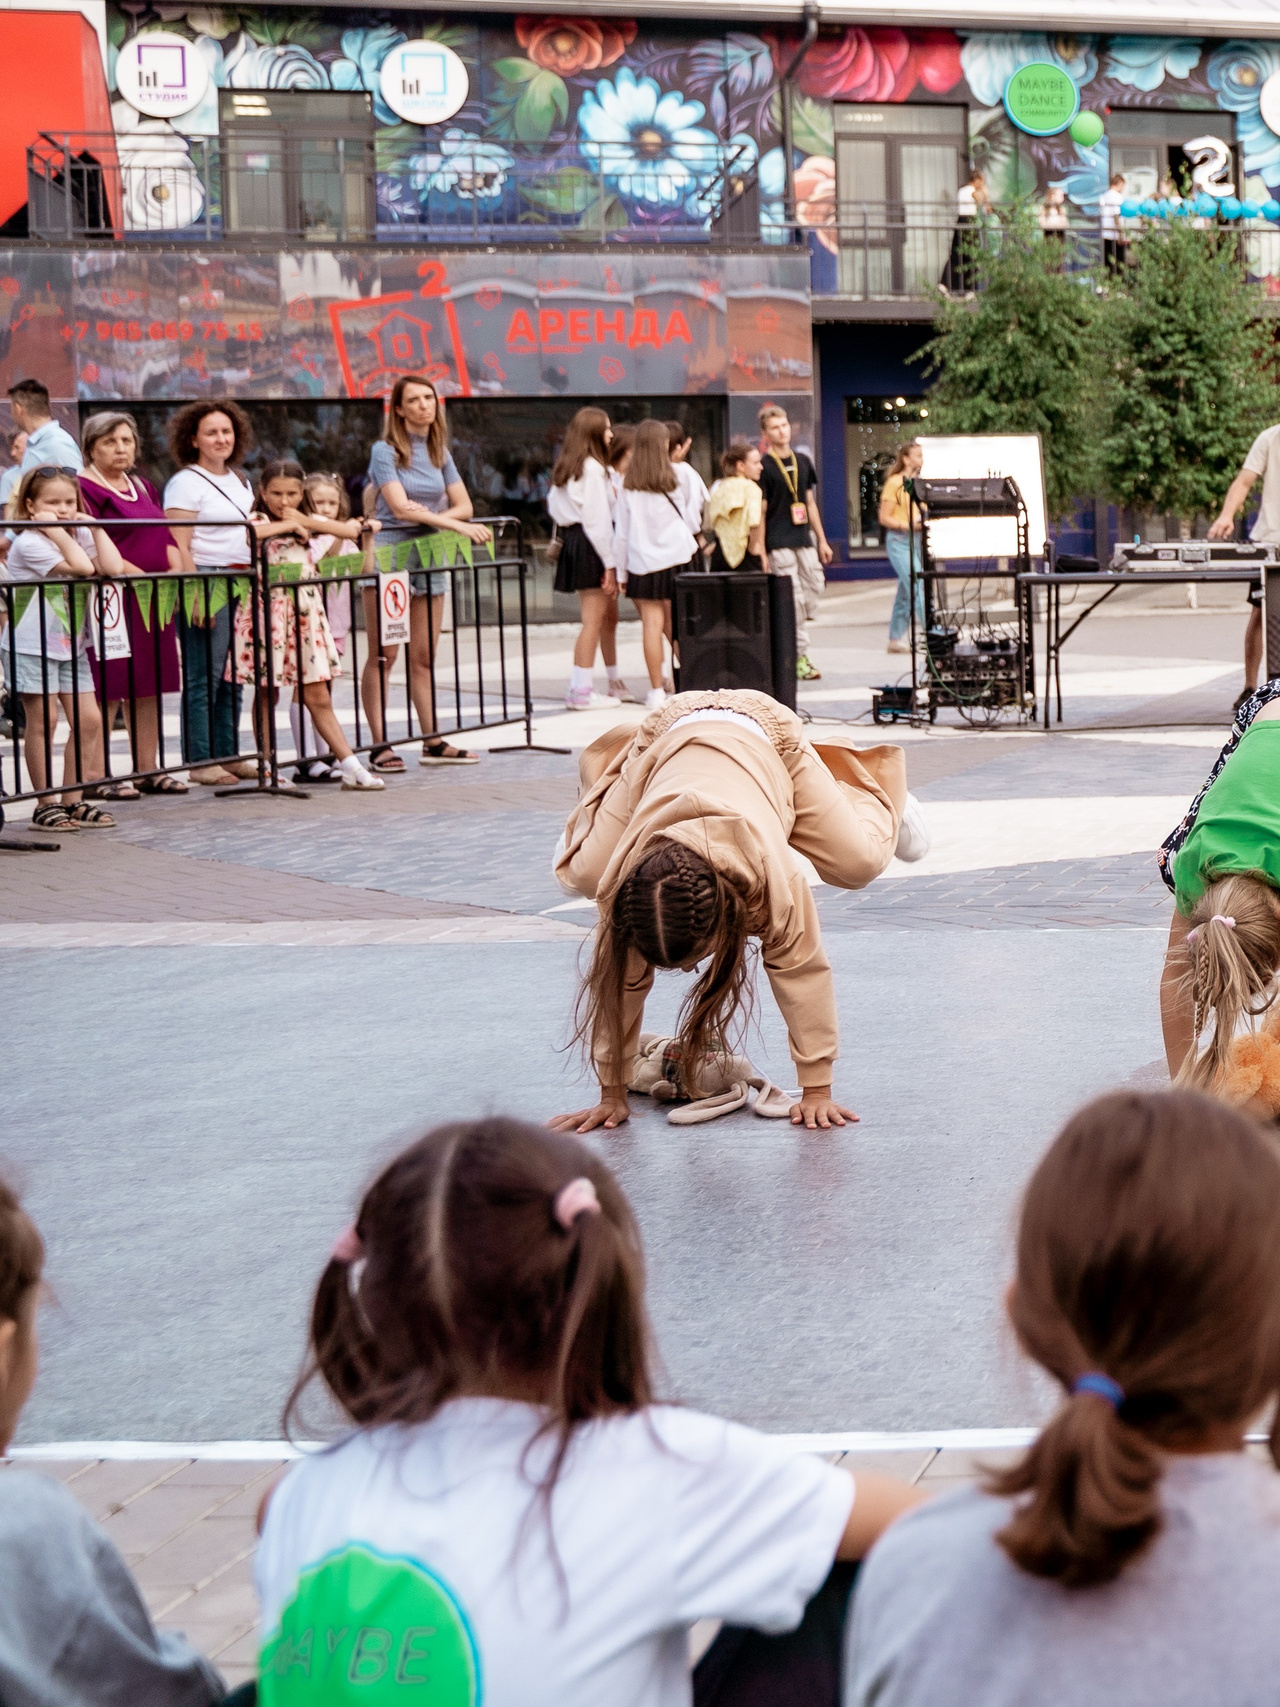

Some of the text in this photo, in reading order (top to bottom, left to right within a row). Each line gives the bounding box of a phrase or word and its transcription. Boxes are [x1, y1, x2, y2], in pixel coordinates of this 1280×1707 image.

[1018, 78, 1067, 92] MAYBE
[139, 93, 188, 102] СТУДИЯ
[1019, 93, 1067, 107] DANCE
[417, 260, 451, 298] 2
[60, 320, 263, 342] +7 965 669 75 15
[506, 308, 693, 349] АРЕНДА
